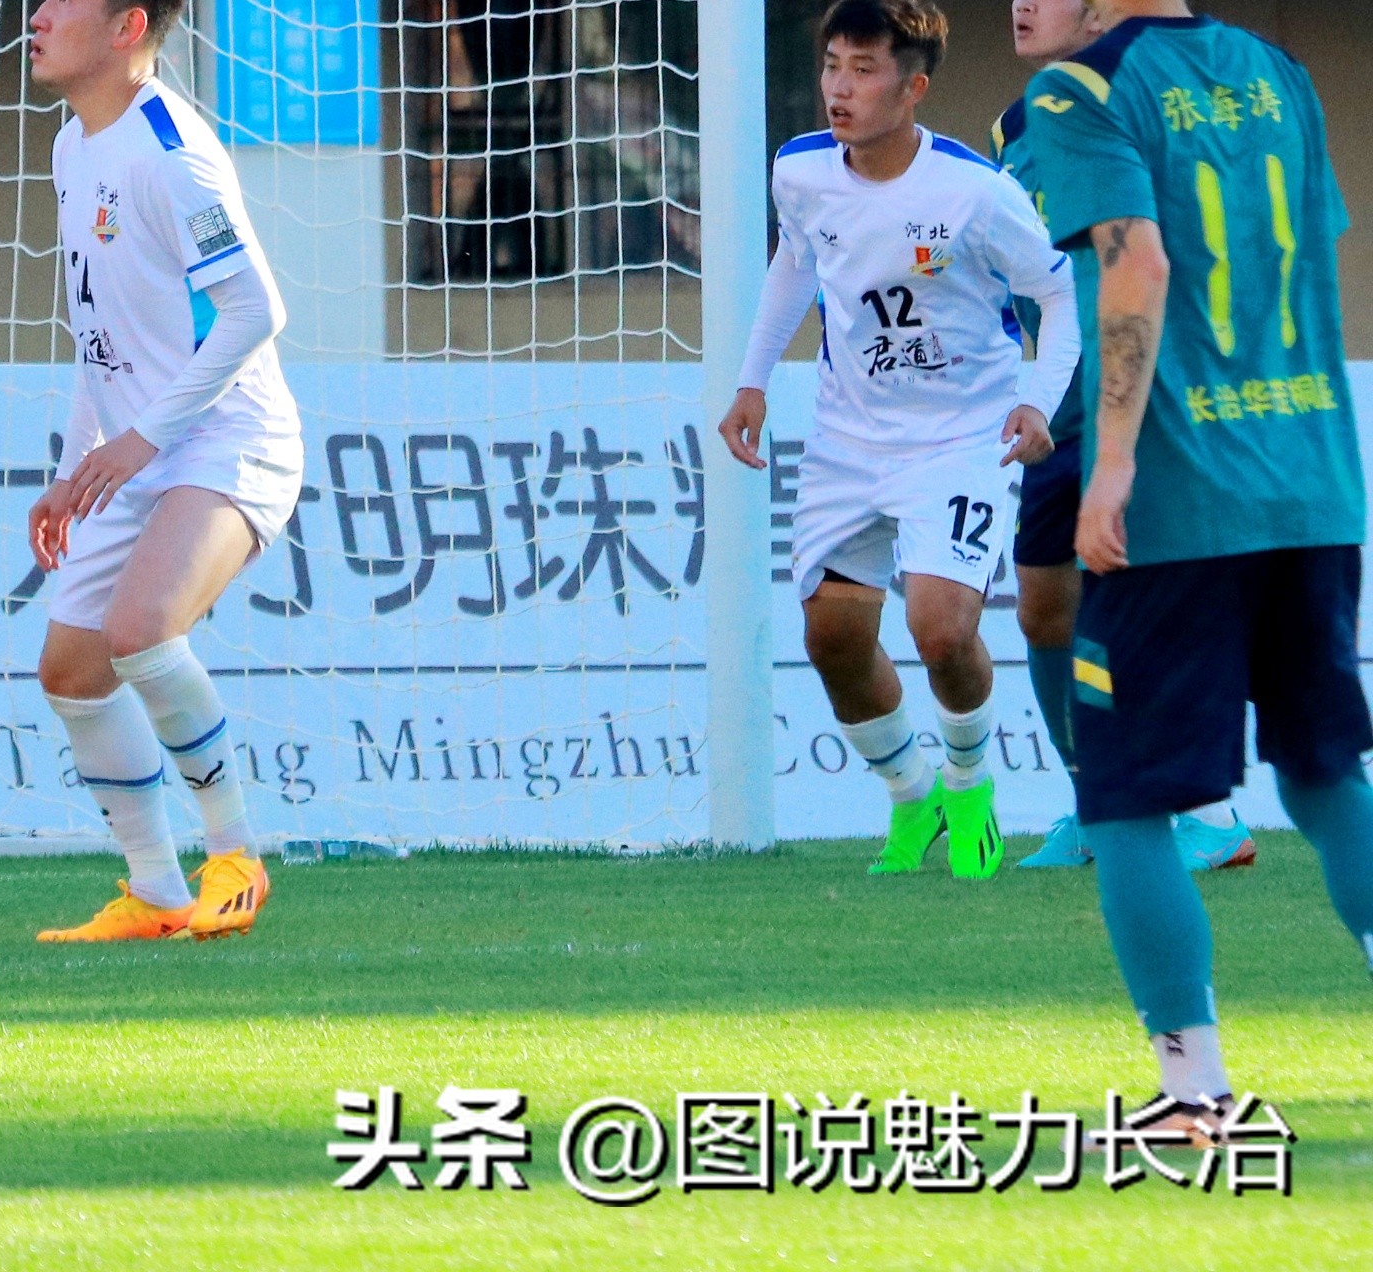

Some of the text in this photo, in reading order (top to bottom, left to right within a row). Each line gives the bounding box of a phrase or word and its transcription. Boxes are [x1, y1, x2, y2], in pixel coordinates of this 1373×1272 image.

[905, 222, 950, 240] 河北
[1195, 153, 1297, 358] 11
[860, 284, 923, 328] 12
[948, 495, 993, 554] 12
[349, 711, 701, 800] Mingzhu
